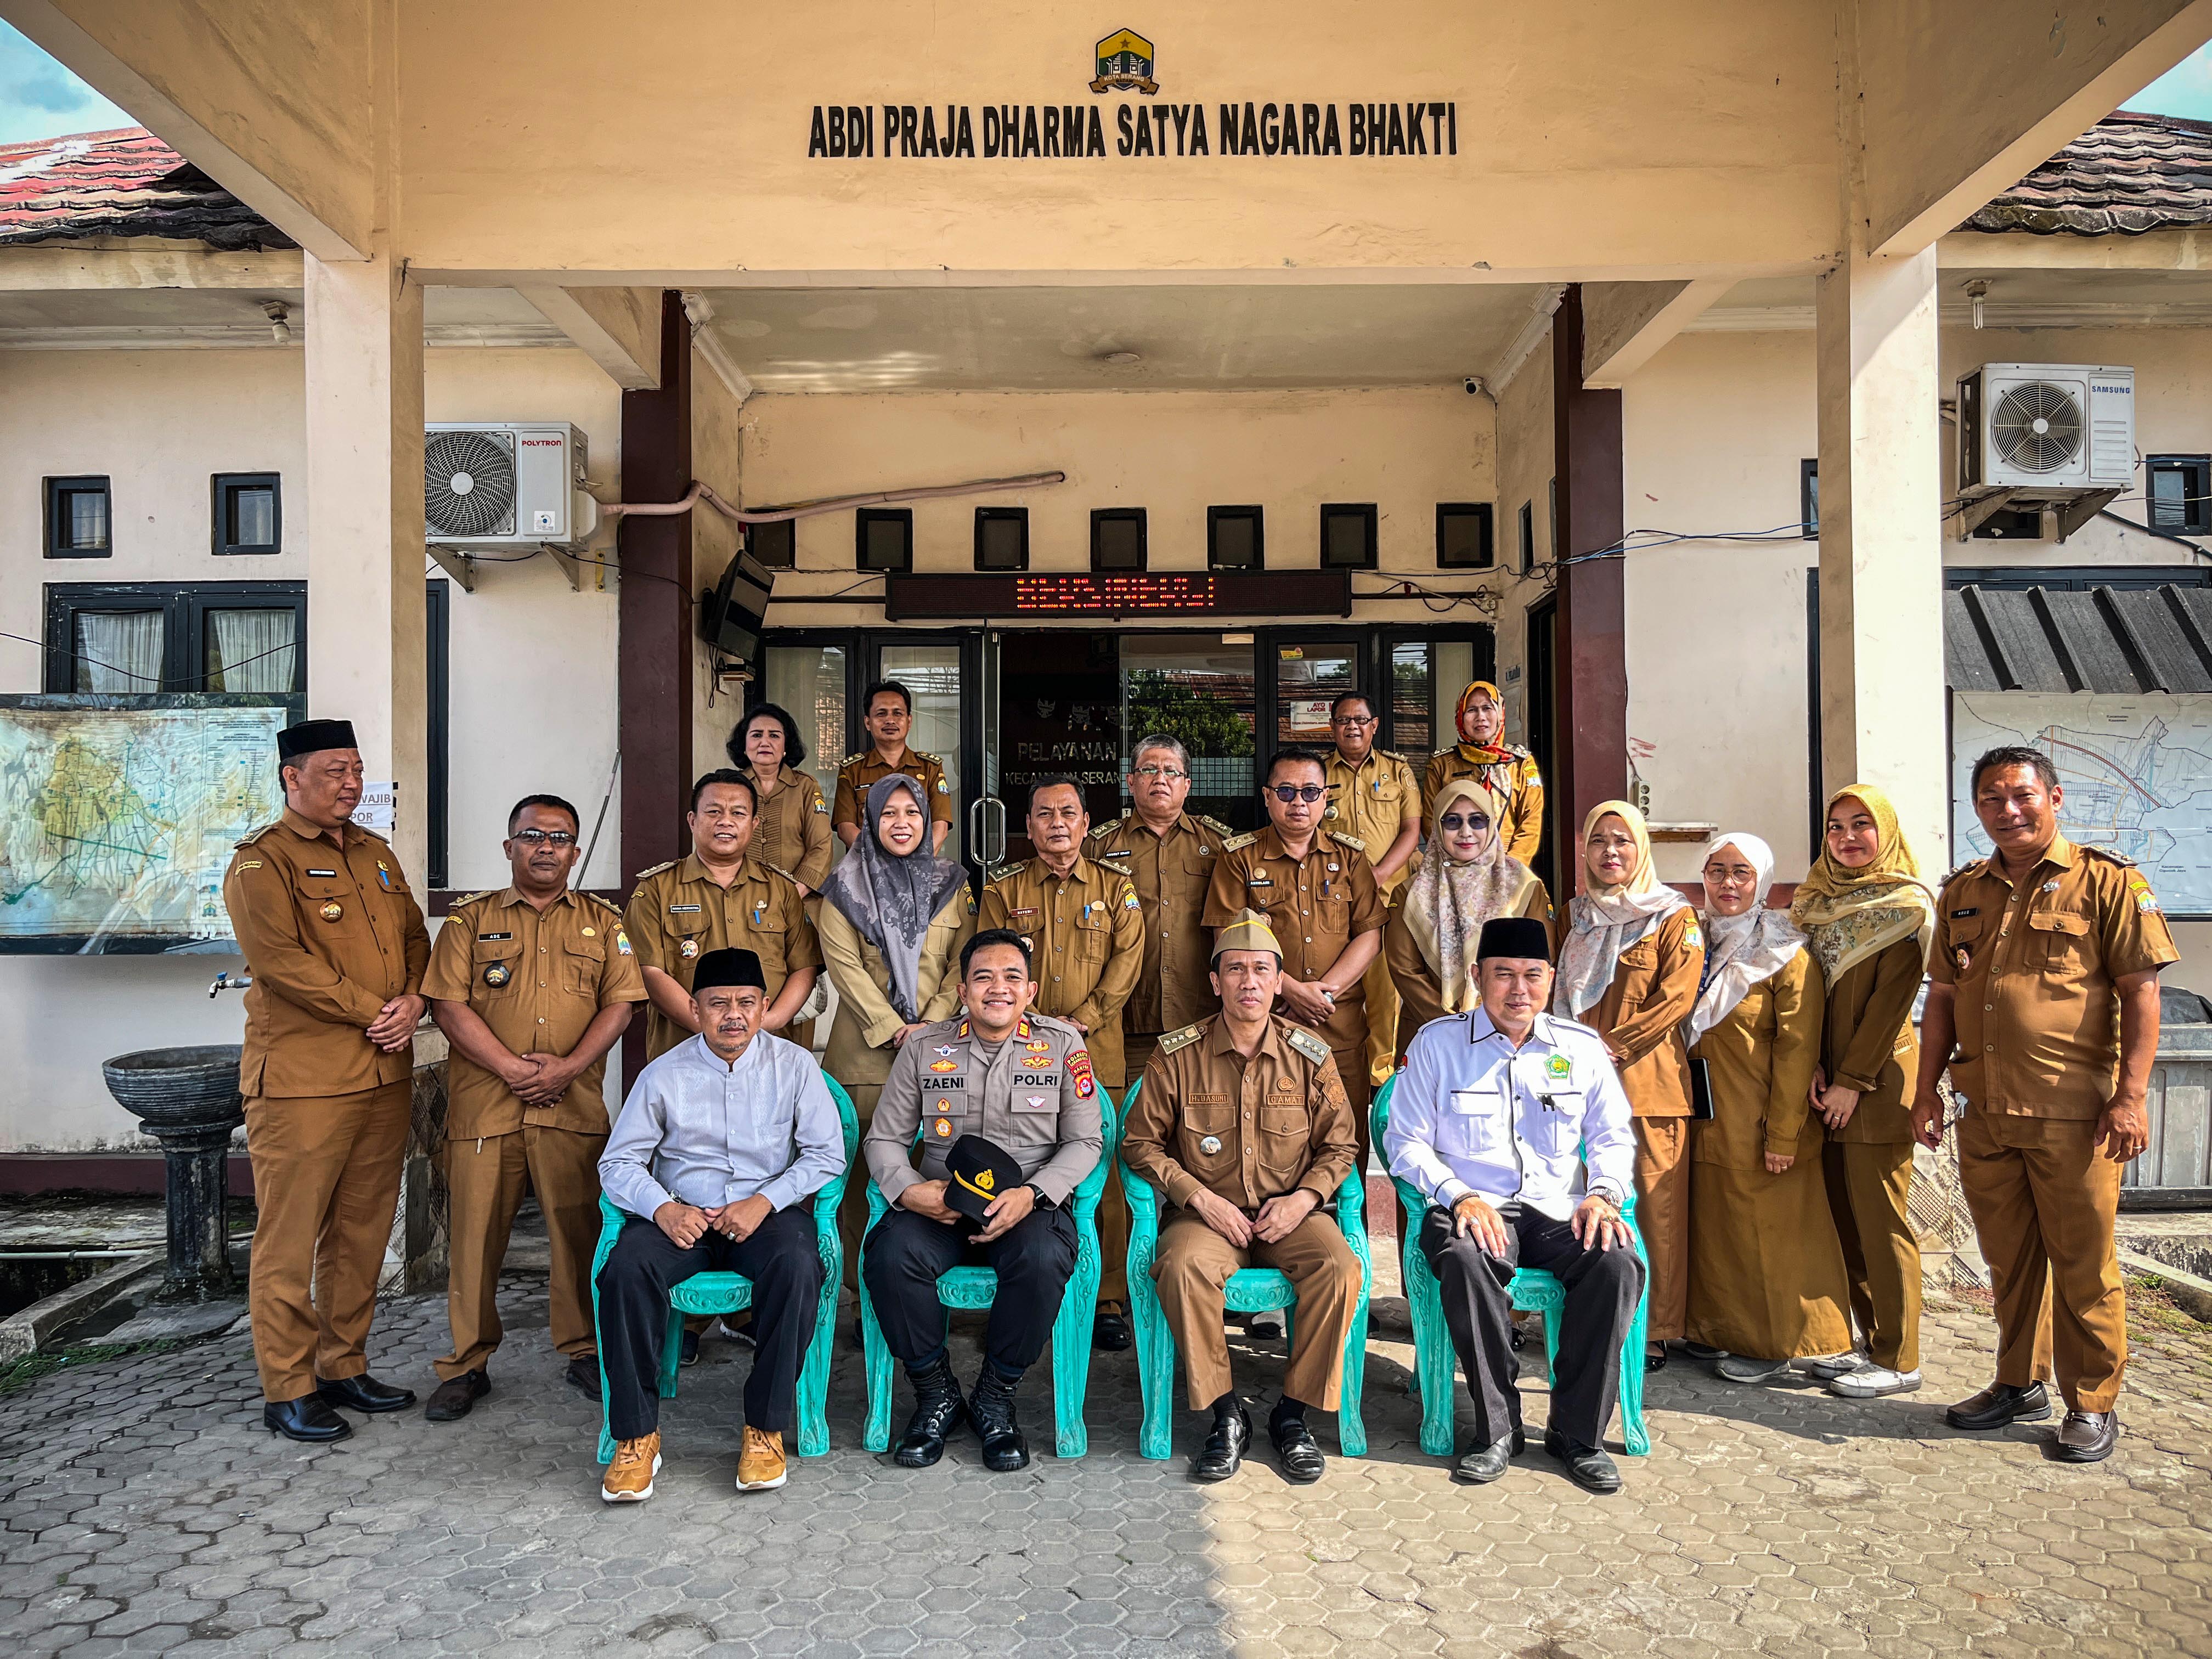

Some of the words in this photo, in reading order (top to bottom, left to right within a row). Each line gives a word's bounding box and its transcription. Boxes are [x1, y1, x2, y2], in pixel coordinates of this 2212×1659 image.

[1121, 74, 1145, 82] SERANG
[808, 105, 873, 158] ABDI
[883, 105, 975, 158] PRAJA
[983, 104, 1107, 158] DHARMA
[1117, 104, 1209, 157] SATYA
[1220, 101, 1342, 156] NAGARA
[1349, 102, 1457, 156] BHAKTI
[2092, 386, 2130, 394] SAMSUNG
[1018, 742, 1117, 761] PELAYANAN
[1081, 771, 1121, 785] SERAN
[923, 1077, 964, 1089] ZAENI
[1013, 1075, 1058, 1086] POLRI
